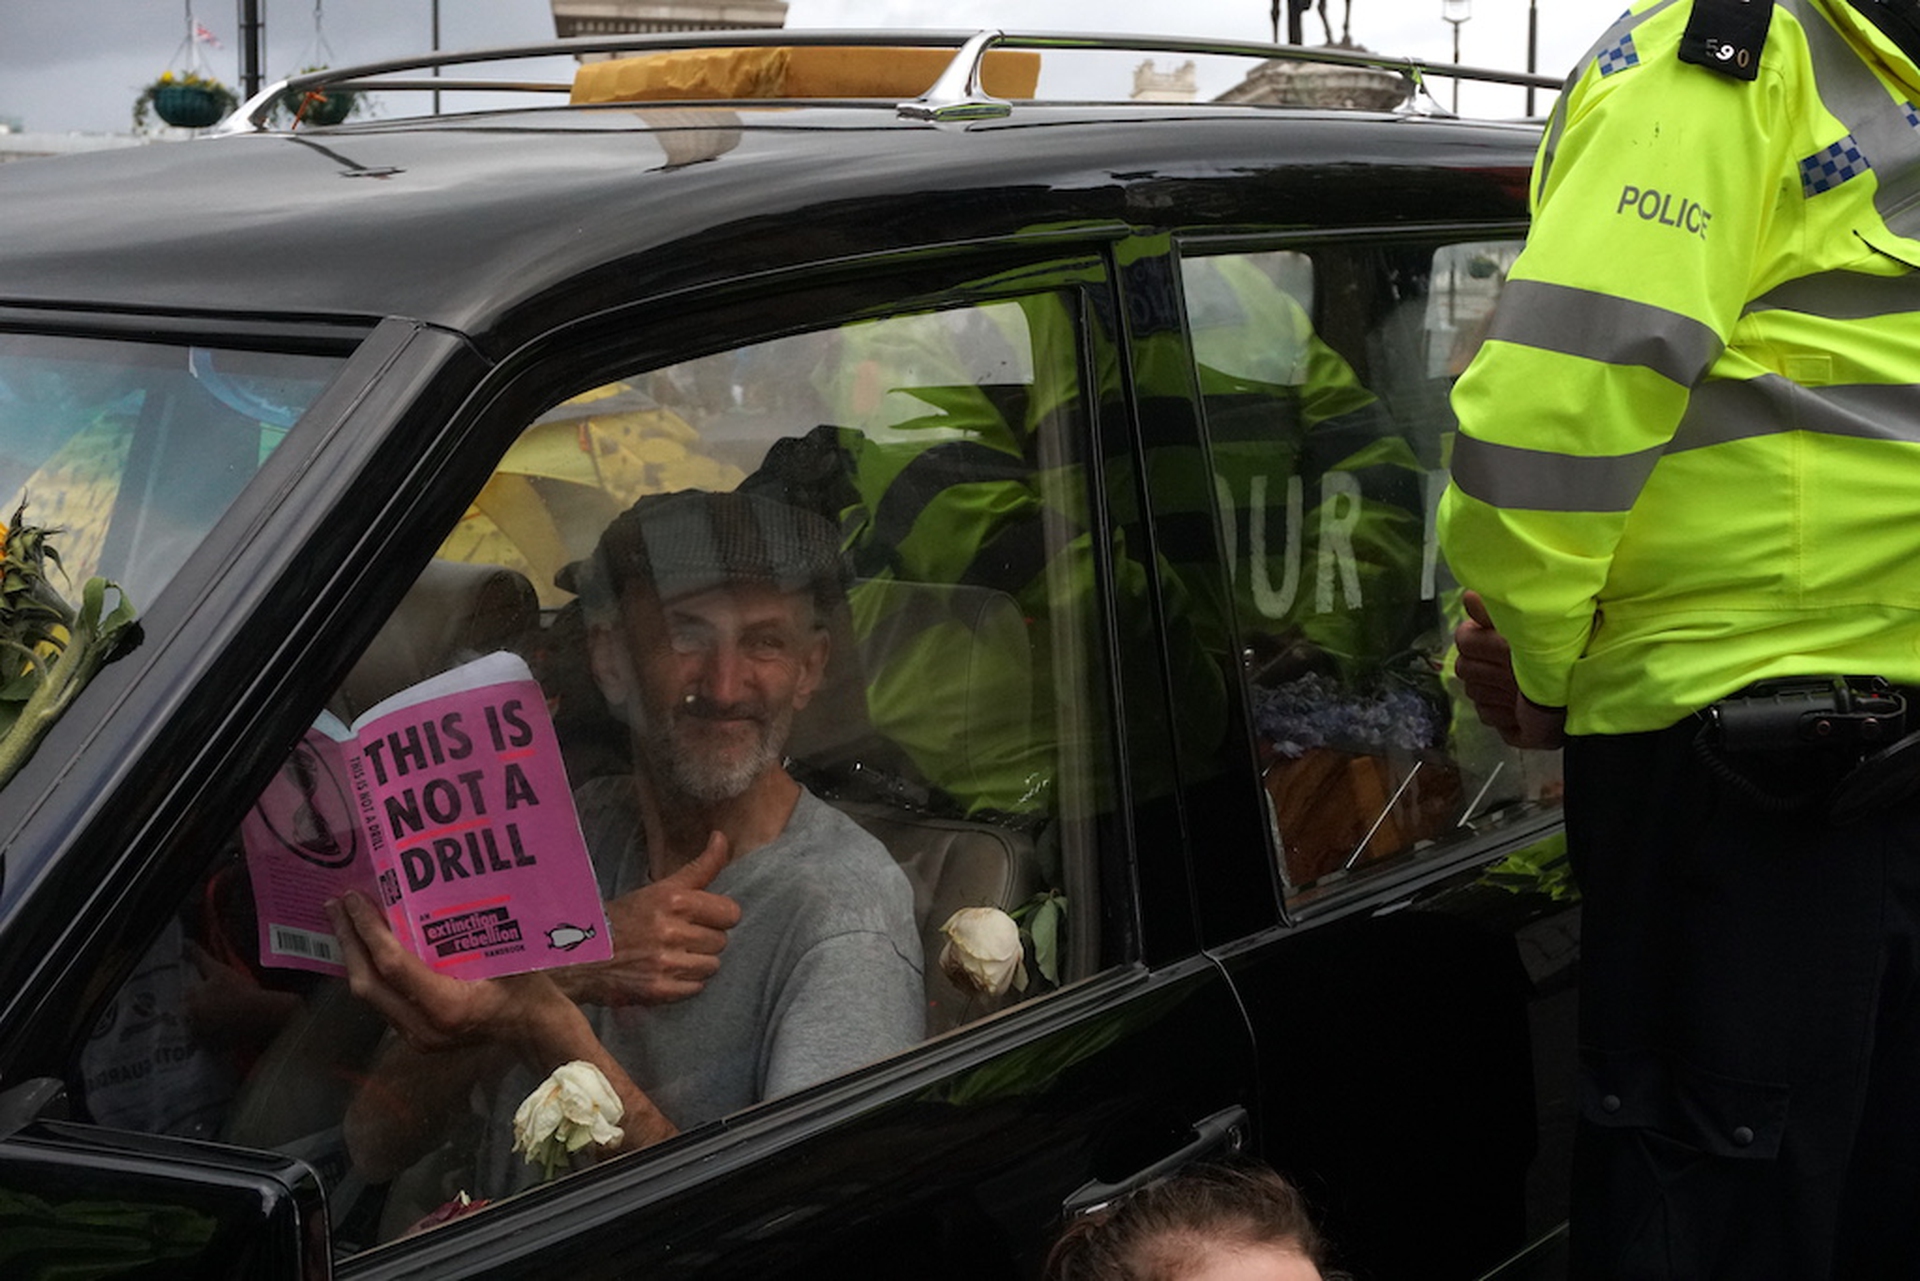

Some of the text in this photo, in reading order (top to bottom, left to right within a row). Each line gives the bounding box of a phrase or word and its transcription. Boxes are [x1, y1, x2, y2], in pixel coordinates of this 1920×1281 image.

[1705, 38, 1751, 68] 590
[1616, 185, 1713, 241] POLICE
[363, 700, 533, 787] THIS IS
[350, 756, 386, 852] THIS IS NOT A DRILL
[383, 764, 540, 839] NOT A
[400, 823, 537, 893] DRILL
[427, 912, 499, 940] extinction
[454, 926, 520, 951] rebellion
[485, 944, 527, 958] HANDBOOK
